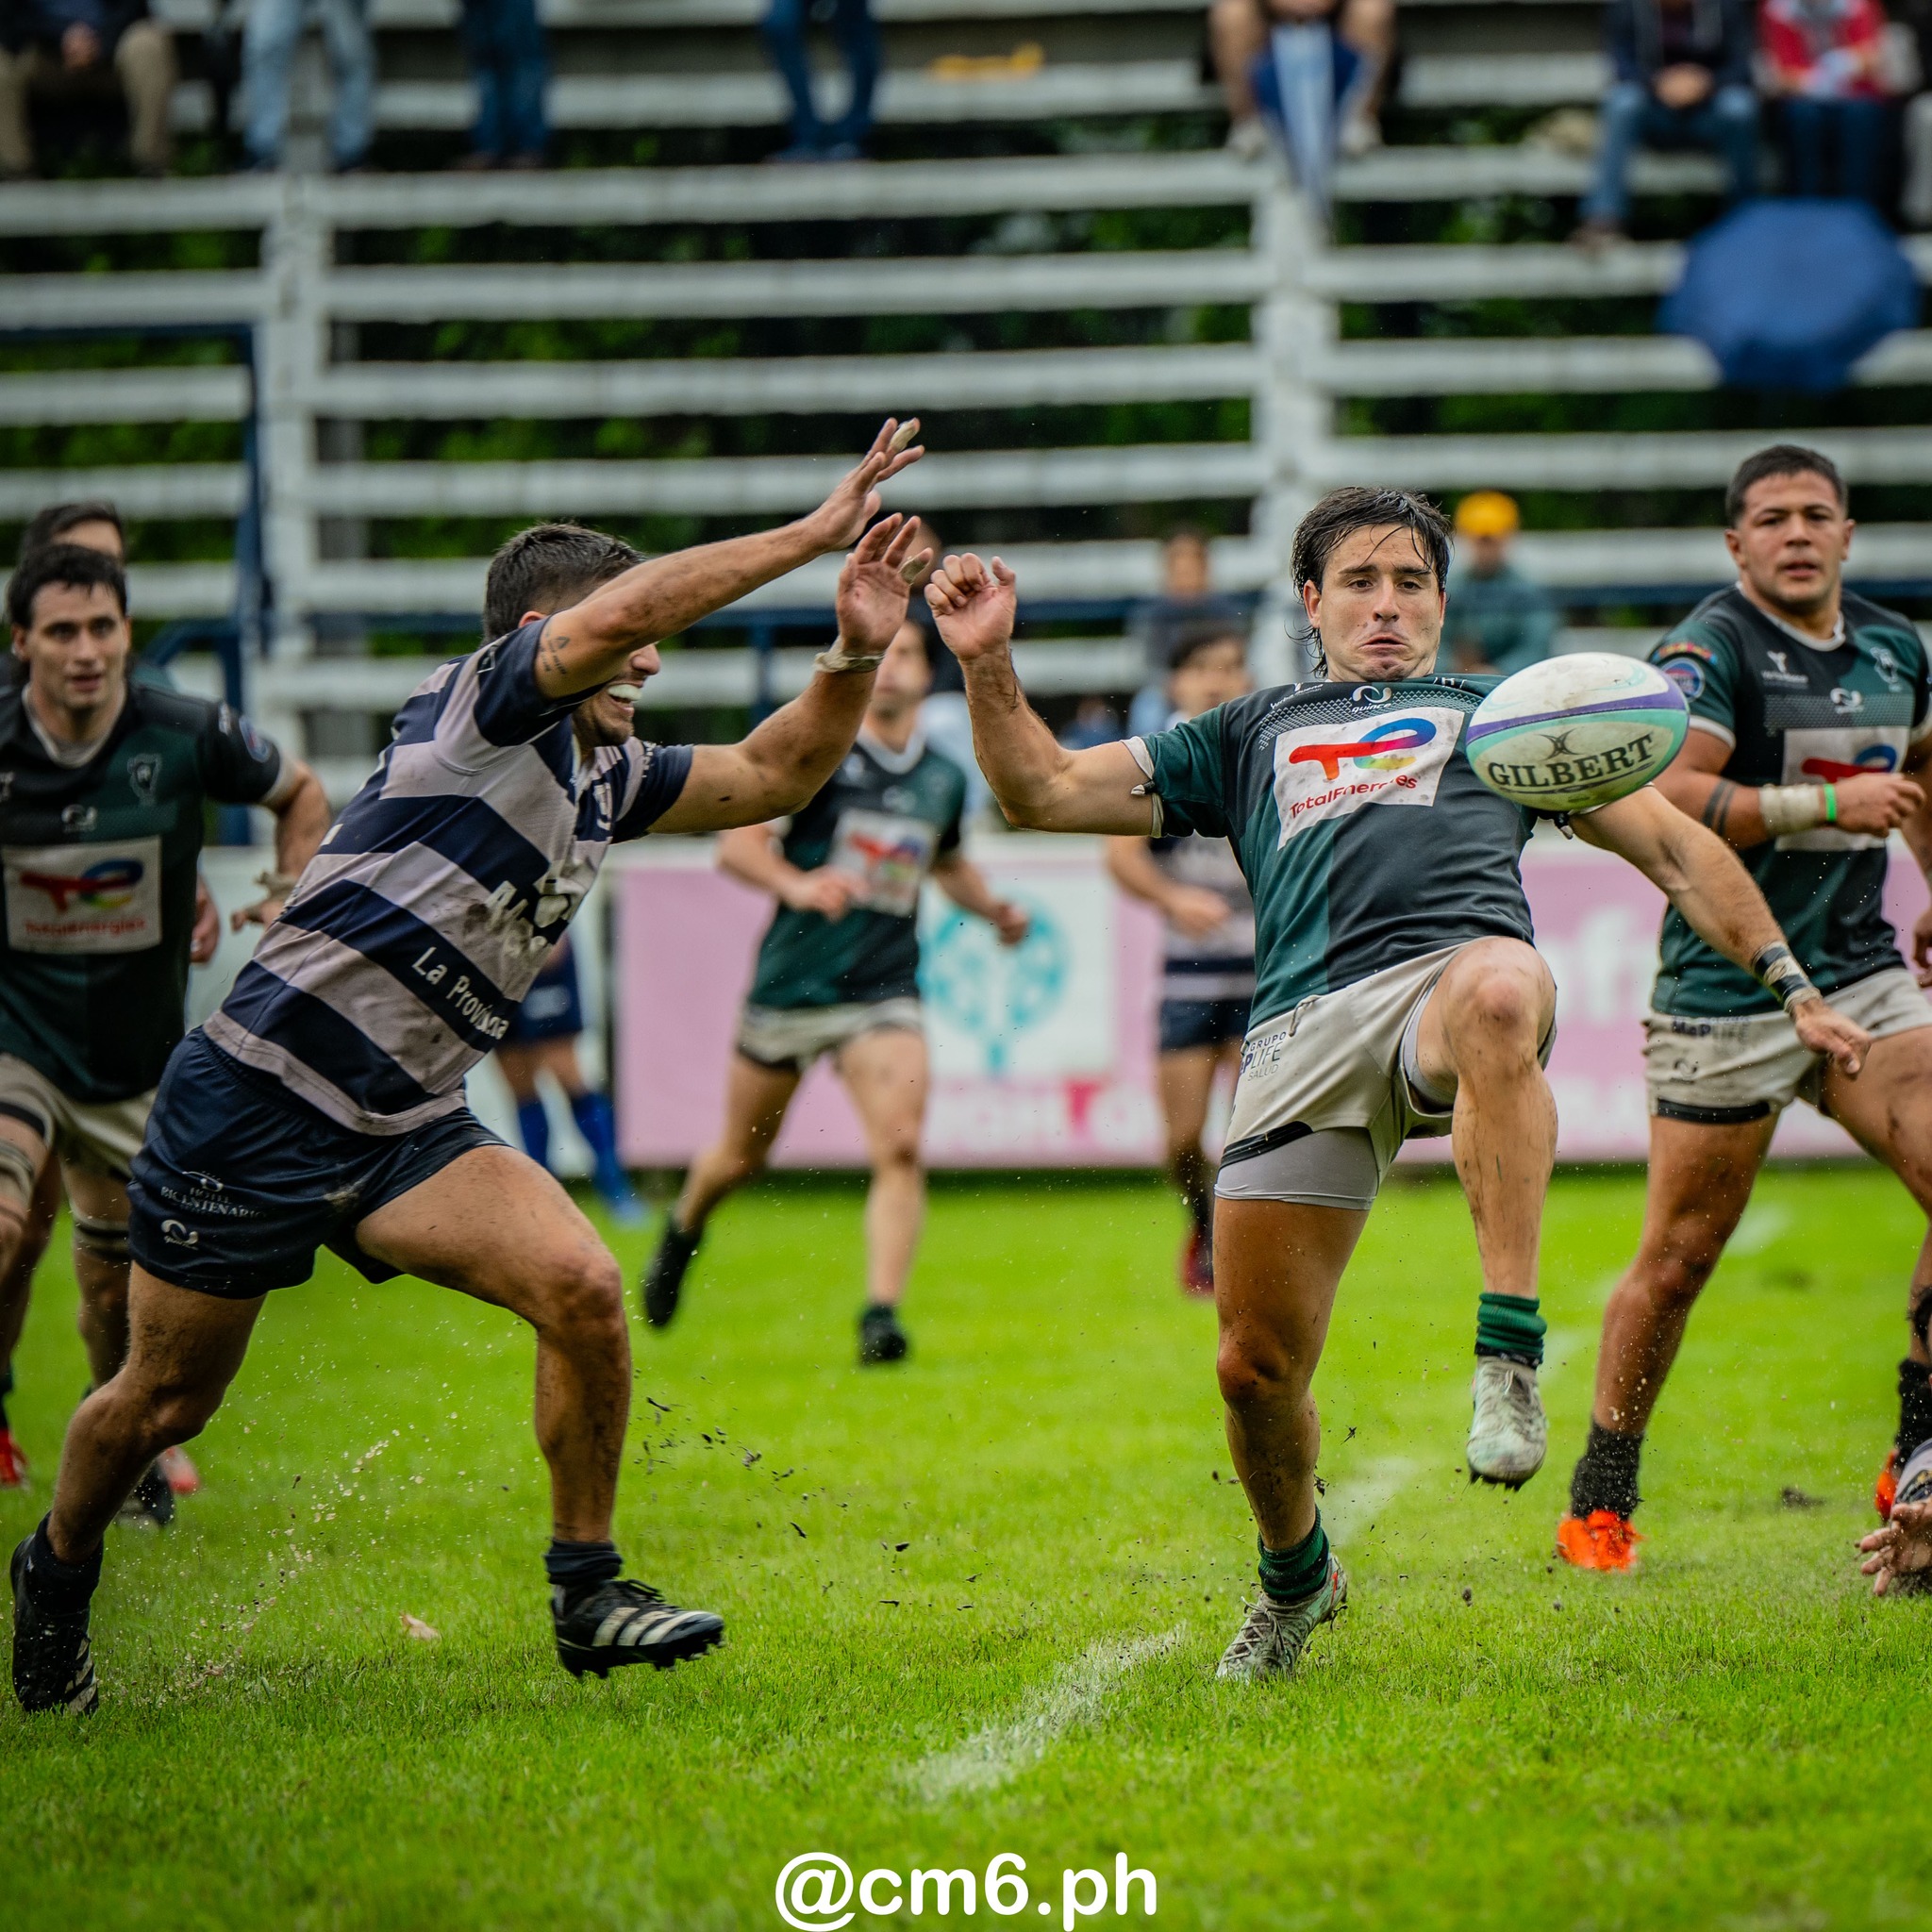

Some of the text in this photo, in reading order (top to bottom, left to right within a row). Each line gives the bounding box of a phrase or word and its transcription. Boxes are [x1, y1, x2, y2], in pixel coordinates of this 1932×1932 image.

[1351, 702, 1392, 713] quince
[1488, 733, 1653, 788] GILBERT
[1290, 774, 1418, 819] TotalEneres
[411, 946, 448, 985] La
[1250, 1031, 1287, 1052] GRUPO
[1247, 1063, 1279, 1082] SALUD
